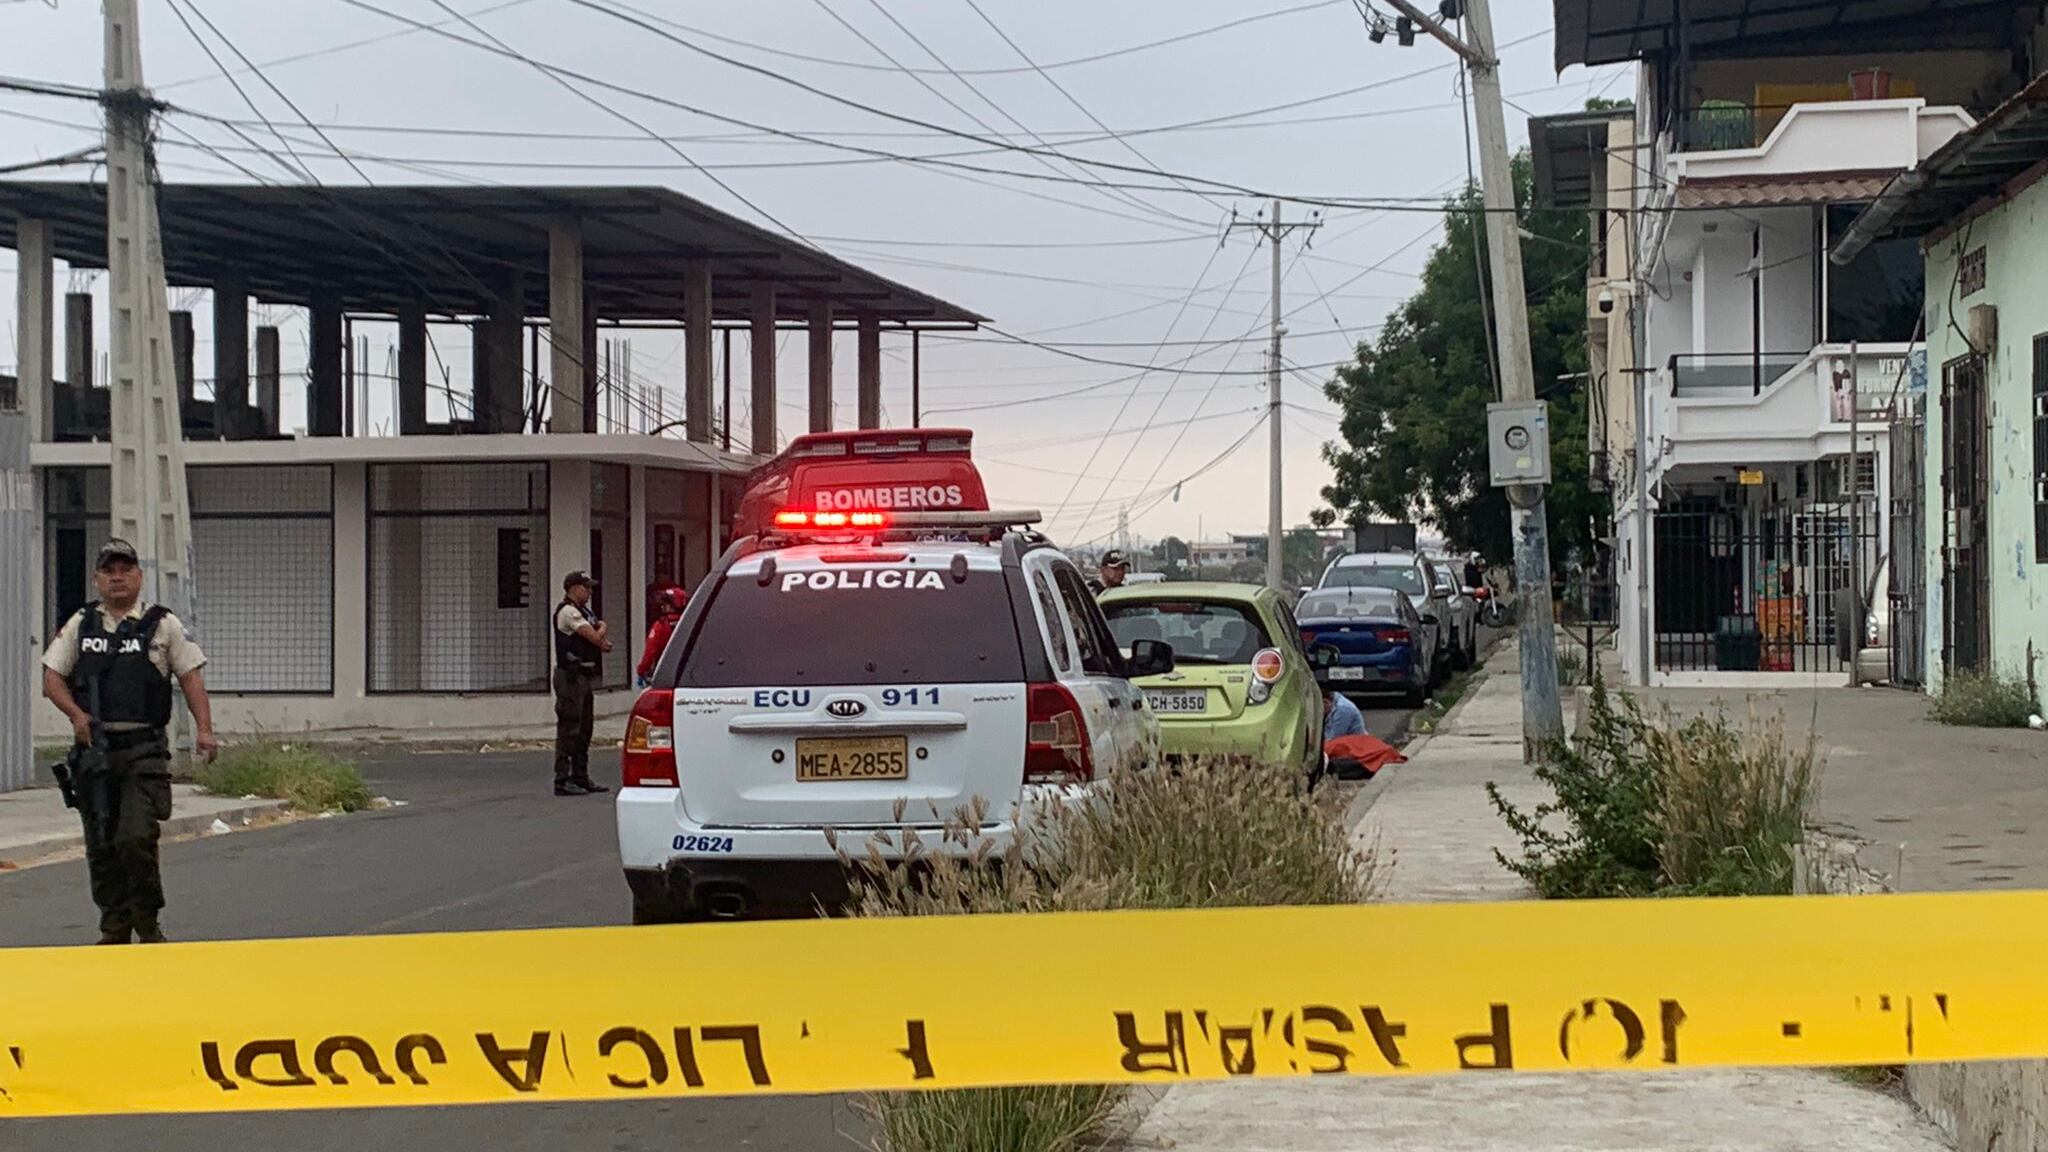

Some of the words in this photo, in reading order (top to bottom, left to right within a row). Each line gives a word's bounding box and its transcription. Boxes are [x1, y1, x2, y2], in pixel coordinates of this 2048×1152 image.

[815, 485, 962, 511] BOMBEROS
[781, 570, 945, 592] POLICIA
[754, 690, 810, 707] ECU
[882, 687, 939, 706] 911
[1146, 696, 1205, 710] CH-5850
[832, 702, 860, 714] KIA
[800, 752, 903, 777] MEA-2855
[672, 835, 734, 852] 02624
